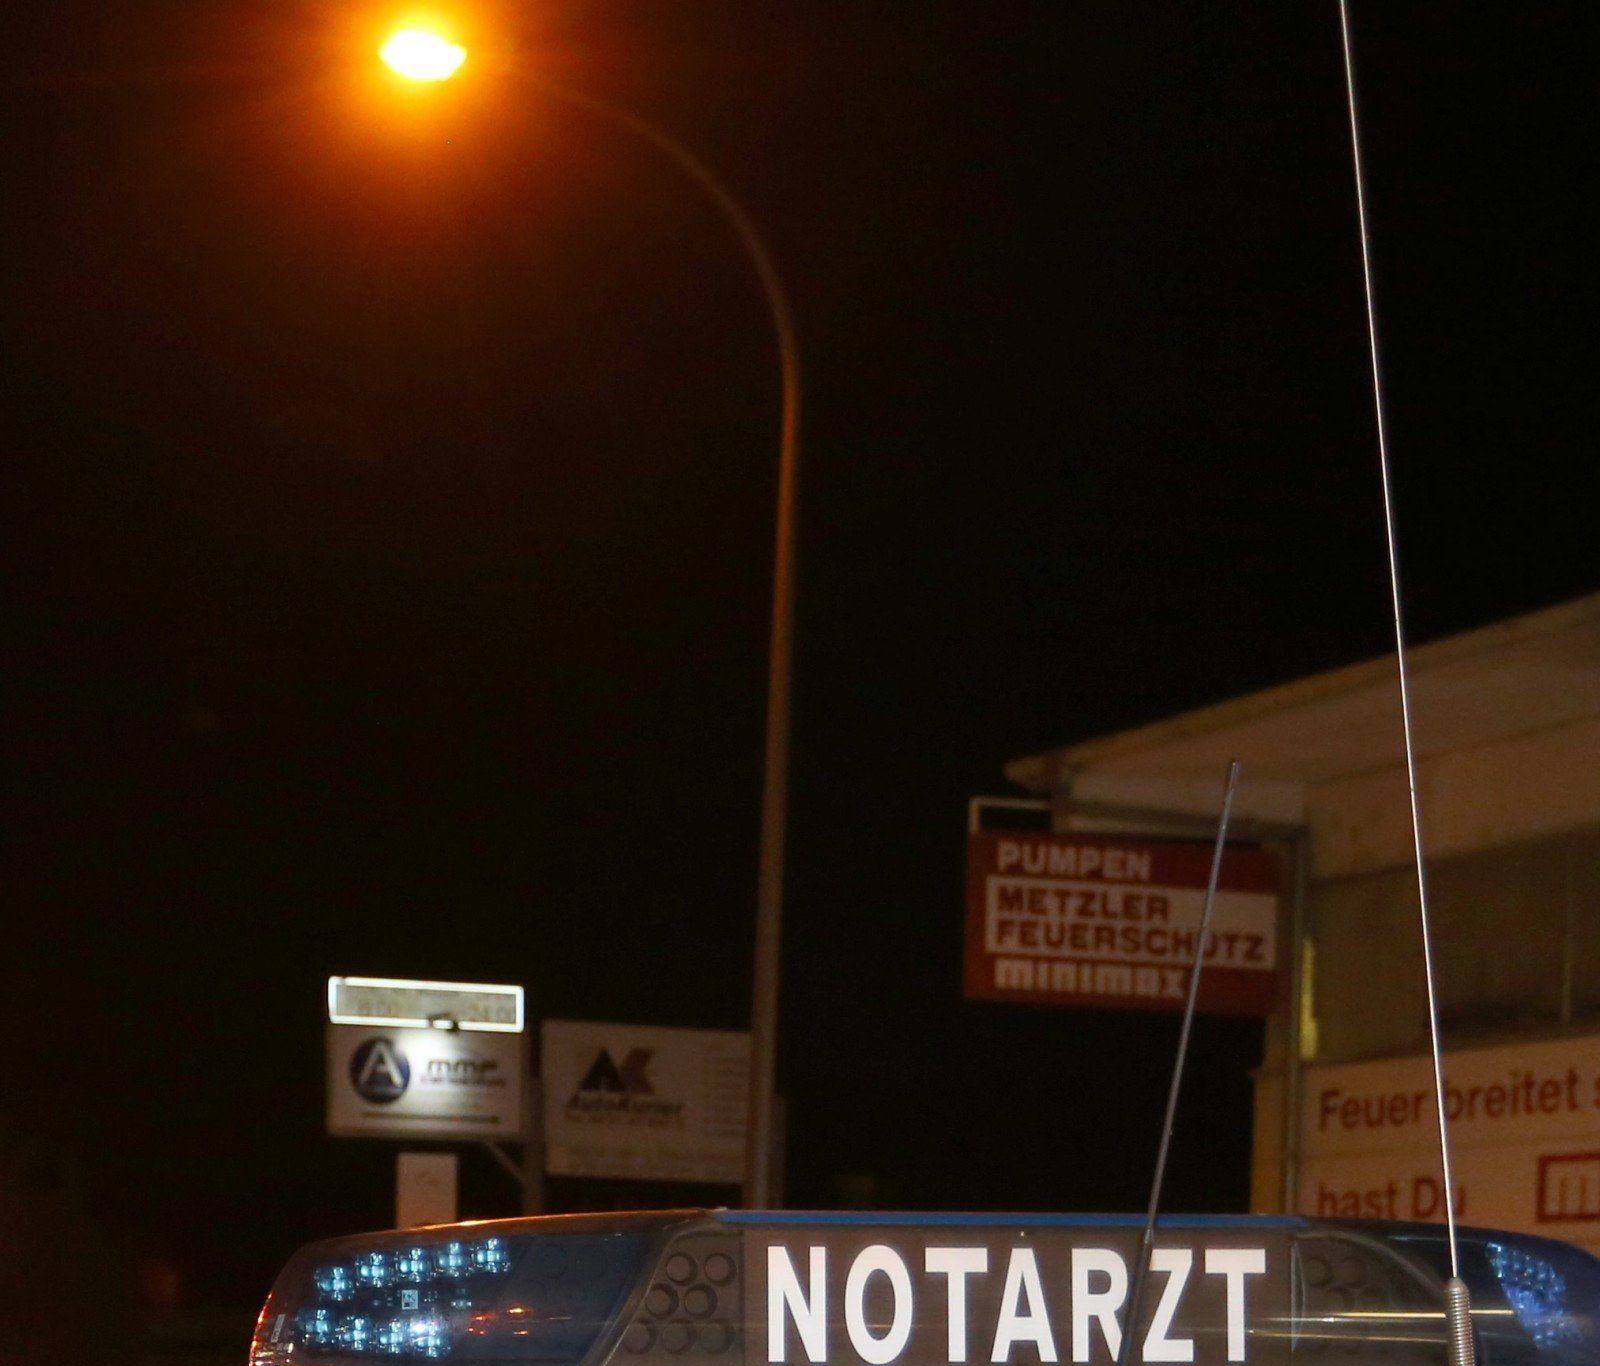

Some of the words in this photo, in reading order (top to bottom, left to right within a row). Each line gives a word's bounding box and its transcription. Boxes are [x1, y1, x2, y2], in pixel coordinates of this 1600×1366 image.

[998, 841, 1151, 881] PUMPEN
[998, 885, 1168, 922] METZLER
[997, 920, 1265, 961] FEUERSCHUTZ
[1318, 1087, 1429, 1132] Feuer
[1442, 1067, 1580, 1122] breitet
[766, 1244, 1267, 1365] NOTARZT
